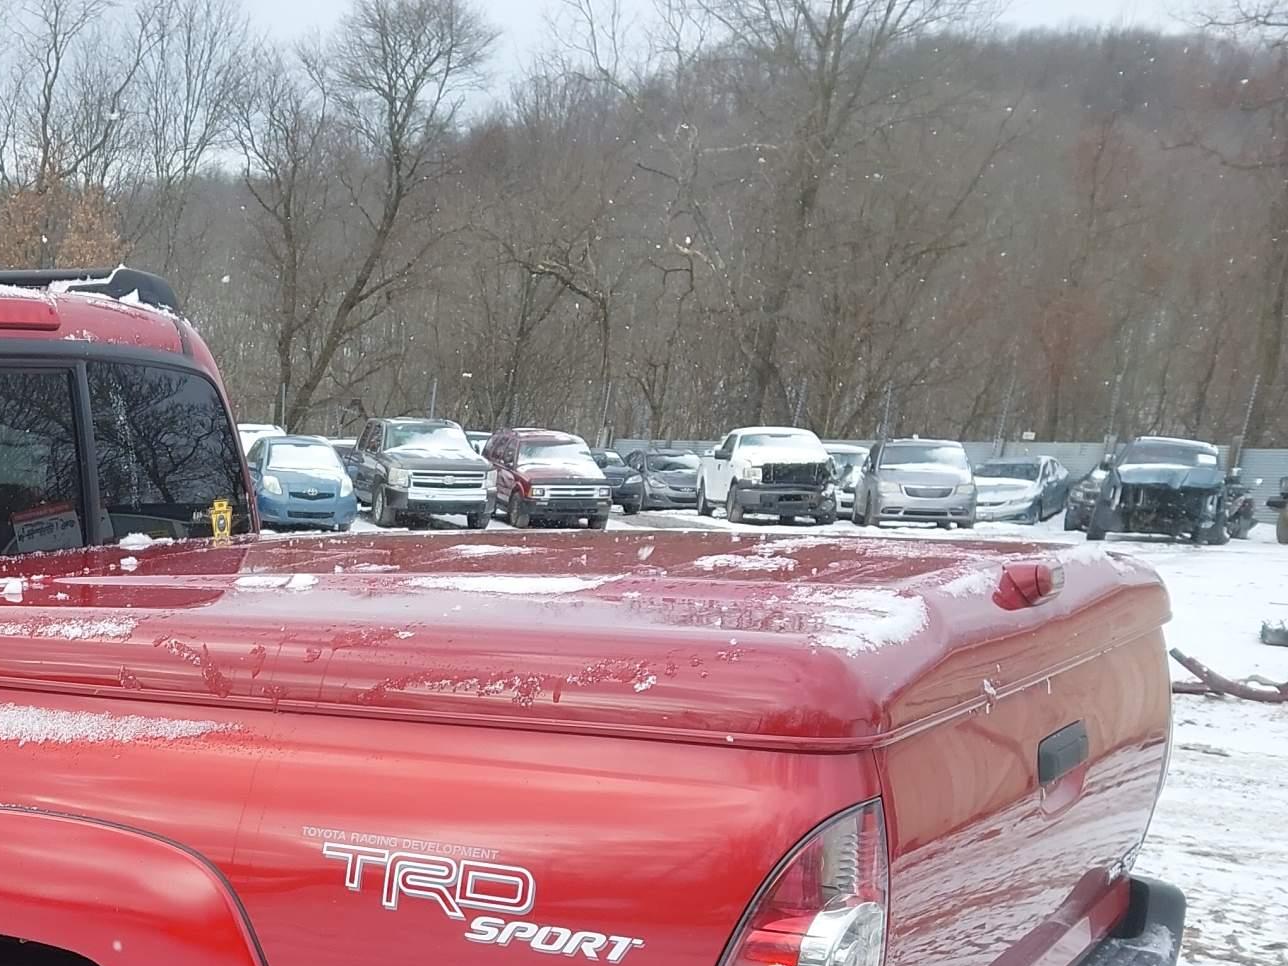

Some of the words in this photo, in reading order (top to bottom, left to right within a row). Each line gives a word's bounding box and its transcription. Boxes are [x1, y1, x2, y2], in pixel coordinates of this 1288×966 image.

[302, 826, 346, 841] TOYOTA
[350, 832, 398, 848] RACING
[402, 839, 500, 861] DEVELOPMENT
[322, 841, 536, 920] TRD
[464, 916, 646, 964] SPORT
